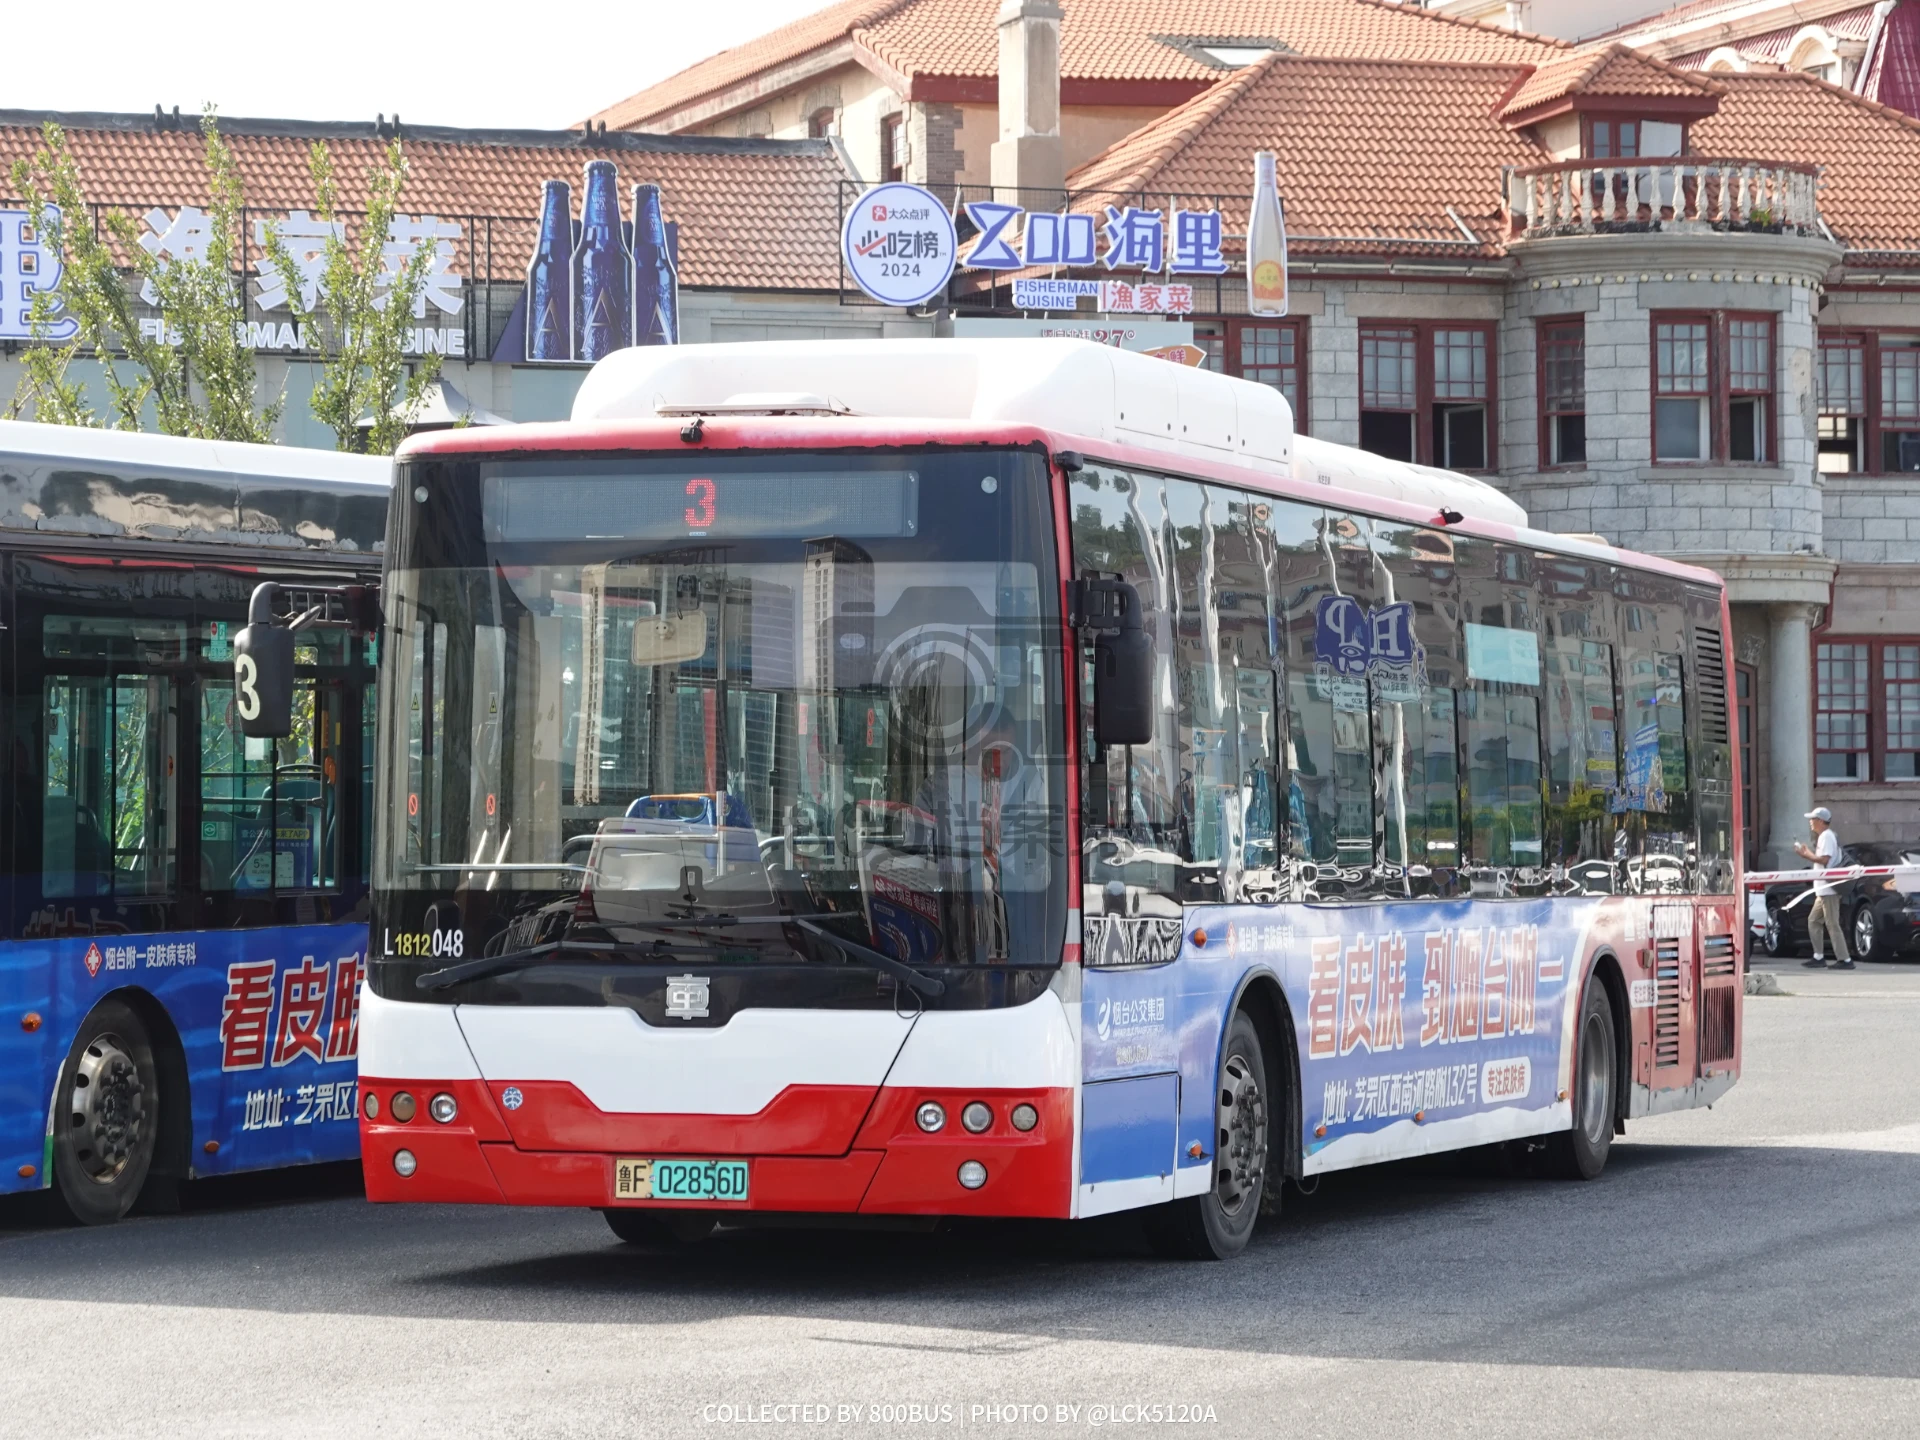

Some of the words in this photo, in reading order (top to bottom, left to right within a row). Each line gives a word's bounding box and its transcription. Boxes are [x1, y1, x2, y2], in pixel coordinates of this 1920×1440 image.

[888, 208, 930, 220] 大众点评
[854, 230, 939, 259] 必吃榜
[881, 263, 921, 277] 2024
[1016, 280, 1098, 294] FISHERMAN
[1016, 294, 1075, 308] CUISINE
[686, 479, 715, 527] 3
[236, 653, 261, 721] 3
[105, 942, 197, 971] 烟台附一皮肤病专科
[384, 927, 464, 958] L1812048
[1307, 929, 1408, 1060] 看皮肤
[1420, 922, 1565, 1048] 到烟台附一
[1112, 997, 1165, 1025] 烟台公交集团
[1487, 1063, 1527, 1098] 专注皮肤病
